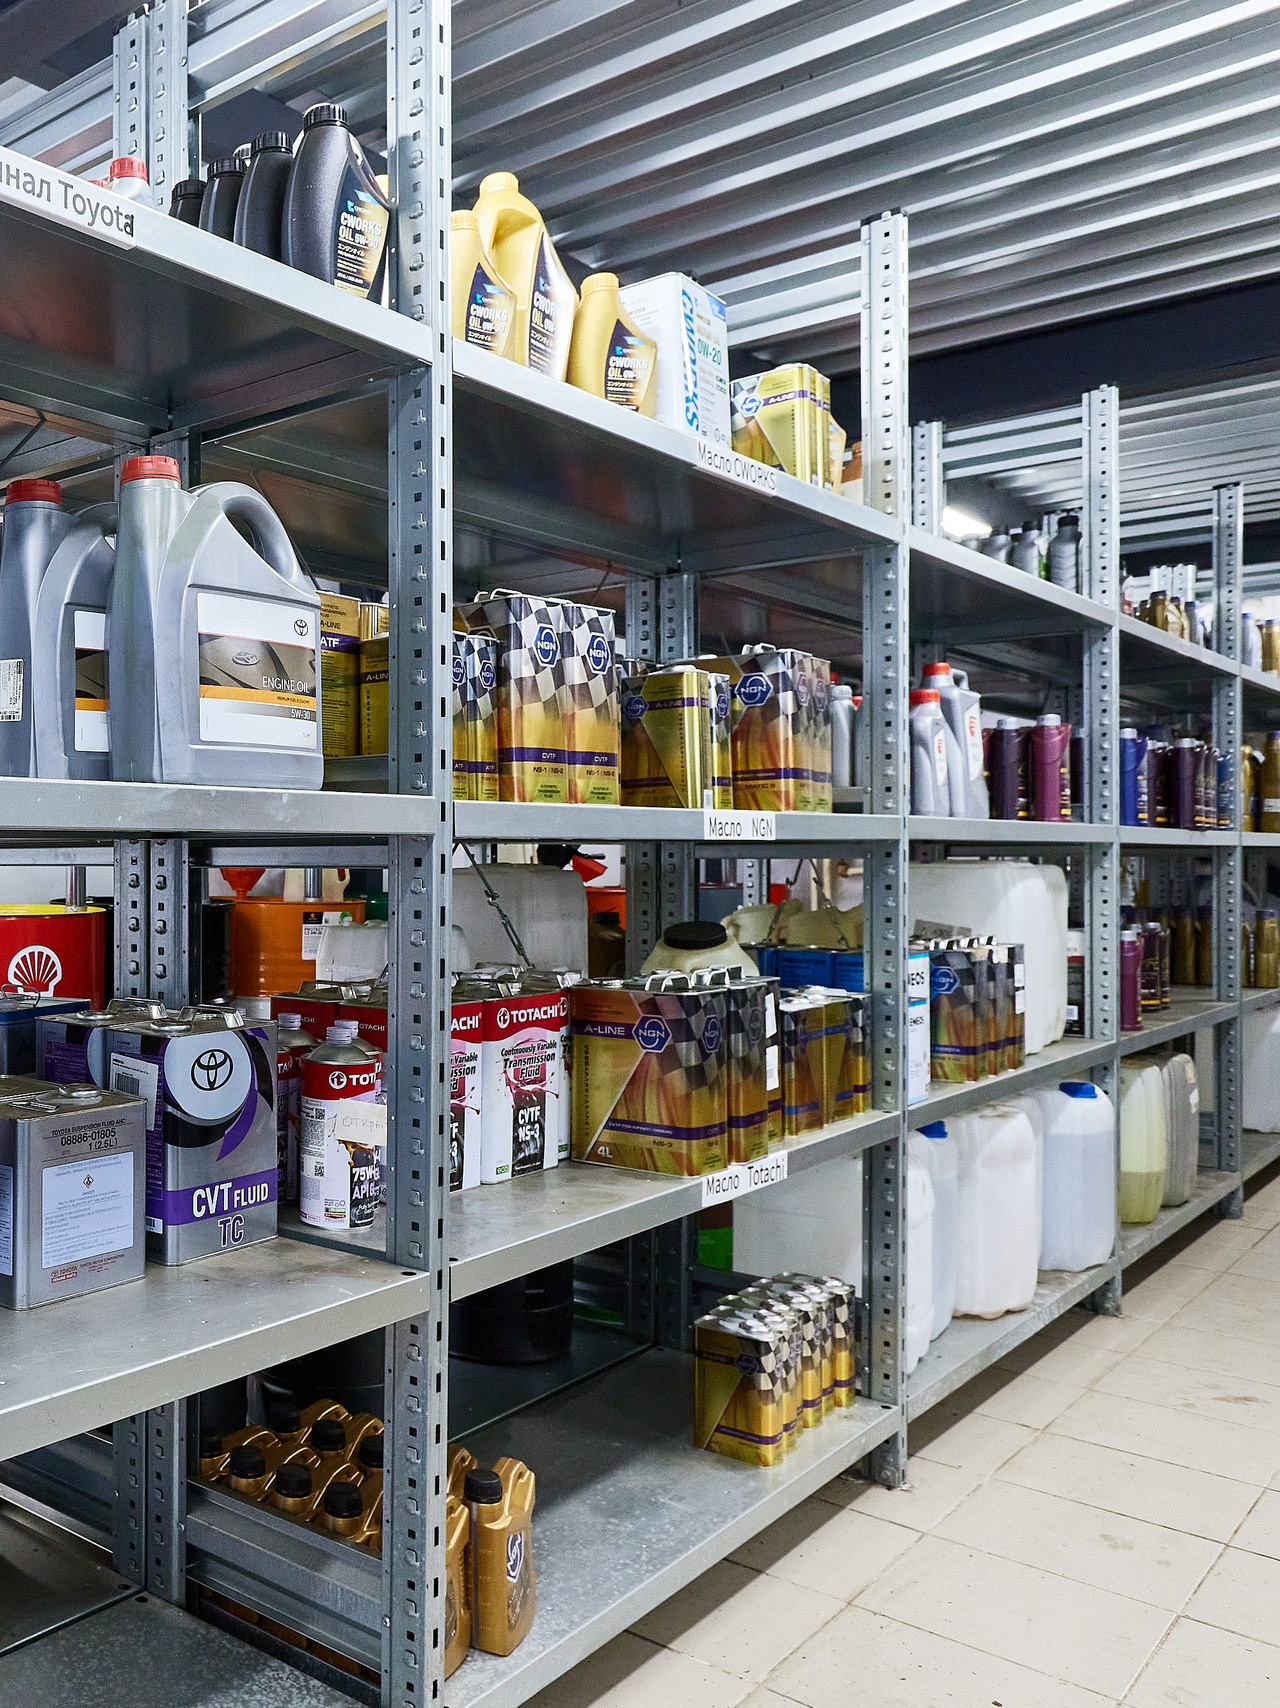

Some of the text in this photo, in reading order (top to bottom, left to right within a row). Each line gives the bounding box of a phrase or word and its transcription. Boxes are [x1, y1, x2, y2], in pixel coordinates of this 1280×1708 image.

[58, 179, 135, 238] Toyota
[340, 212, 382, 236] CWORKS
[339, 226, 379, 249] OIL 5W-30
[470, 304, 508, 321] CWORKS
[531, 308, 543, 327] OIL
[469, 316, 481, 329] OIL
[697, 338, 722, 366] 0W-20
[609, 356, 648, 370] CWORKS
[608, 367, 622, 379] OIL
[769, 392, 796, 405] A-LINE
[697, 442, 776, 491] Масло CWORKS
[320, 619, 341, 629] A-LINE
[320, 636, 340, 648] ATF
[537, 642, 557, 651] NGN
[589, 649, 607, 658] NGN
[262, 675, 310, 694] ENGINE OIL
[740, 685, 767, 693] NGN
[291, 709, 311, 720] 5W-30
[541, 752, 557, 760] CVTF
[594, 755, 608, 763] CVTF
[709, 816, 773, 838] Масло NGN
[451, 1014, 480, 1031] ACHI
[510, 1005, 559, 1024] TOTACHI
[583, 1024, 626, 1036] A-LINE
[638, 1029, 665, 1038] NGN
[704, 1030, 720, 1038] NGN
[500, 1039, 558, 1058] Continuously Variable
[454, 1052, 478, 1064] Variable
[503, 1052, 556, 1069] Transmission
[519, 1065, 540, 1080] Fluid
[518, 1106, 541, 1124] CVTF
[51, 1127, 71, 1137] TOYOTA
[71, 1122, 101, 1133] SUSPENSION
[101, 1120, 116, 1128] FLUID
[518, 1124, 540, 1142] NS-3
[61, 1127, 116, 1147] 08886-01805
[94, 1137, 118, 1151] (2.5L)
[653, 1140, 673, 1148] NS-3
[597, 1146, 613, 1159] 4L
[497, 1165, 509, 1174] eco
[706, 1160, 786, 1196] Масло Totachi
[192, 1181, 269, 1218] CVT FLUID
[352, 1183, 369, 1200] API
[218, 1214, 245, 1248] TC
